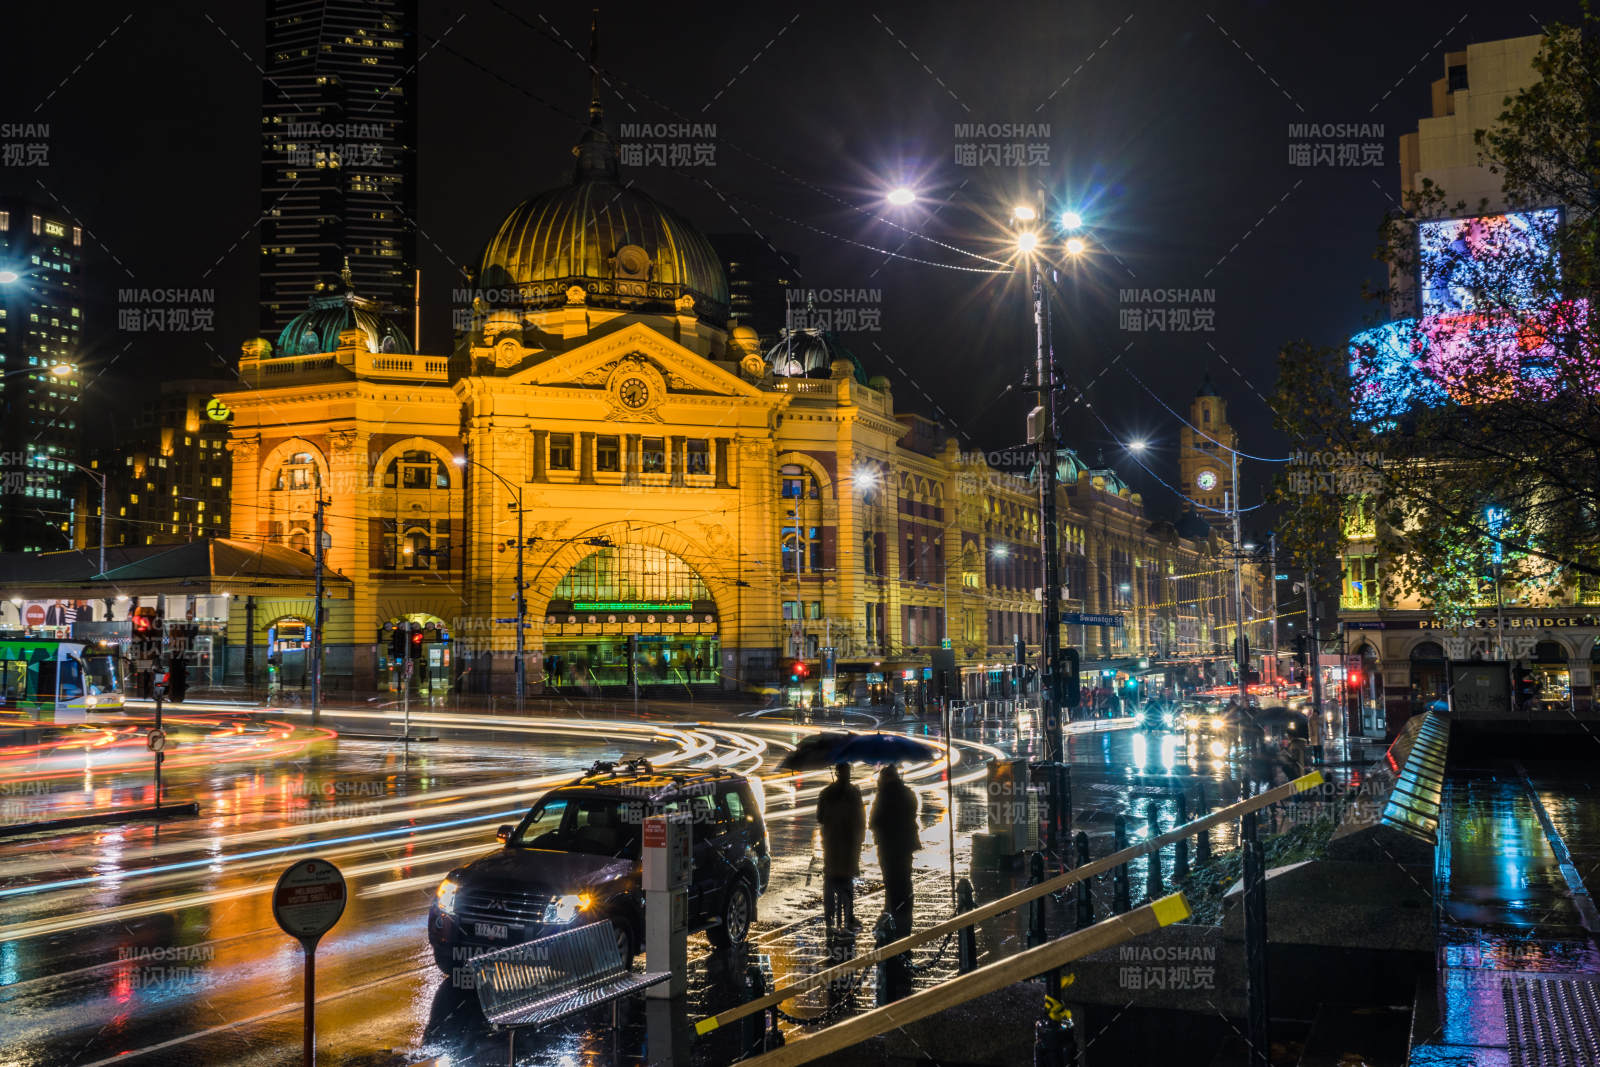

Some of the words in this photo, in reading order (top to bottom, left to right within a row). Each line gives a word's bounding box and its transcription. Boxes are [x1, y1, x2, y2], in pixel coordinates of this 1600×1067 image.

[46, 222, 64, 237] IBM
[1080, 614, 1113, 623] Swanston
[1511, 618, 1578, 628] BRIDGE
